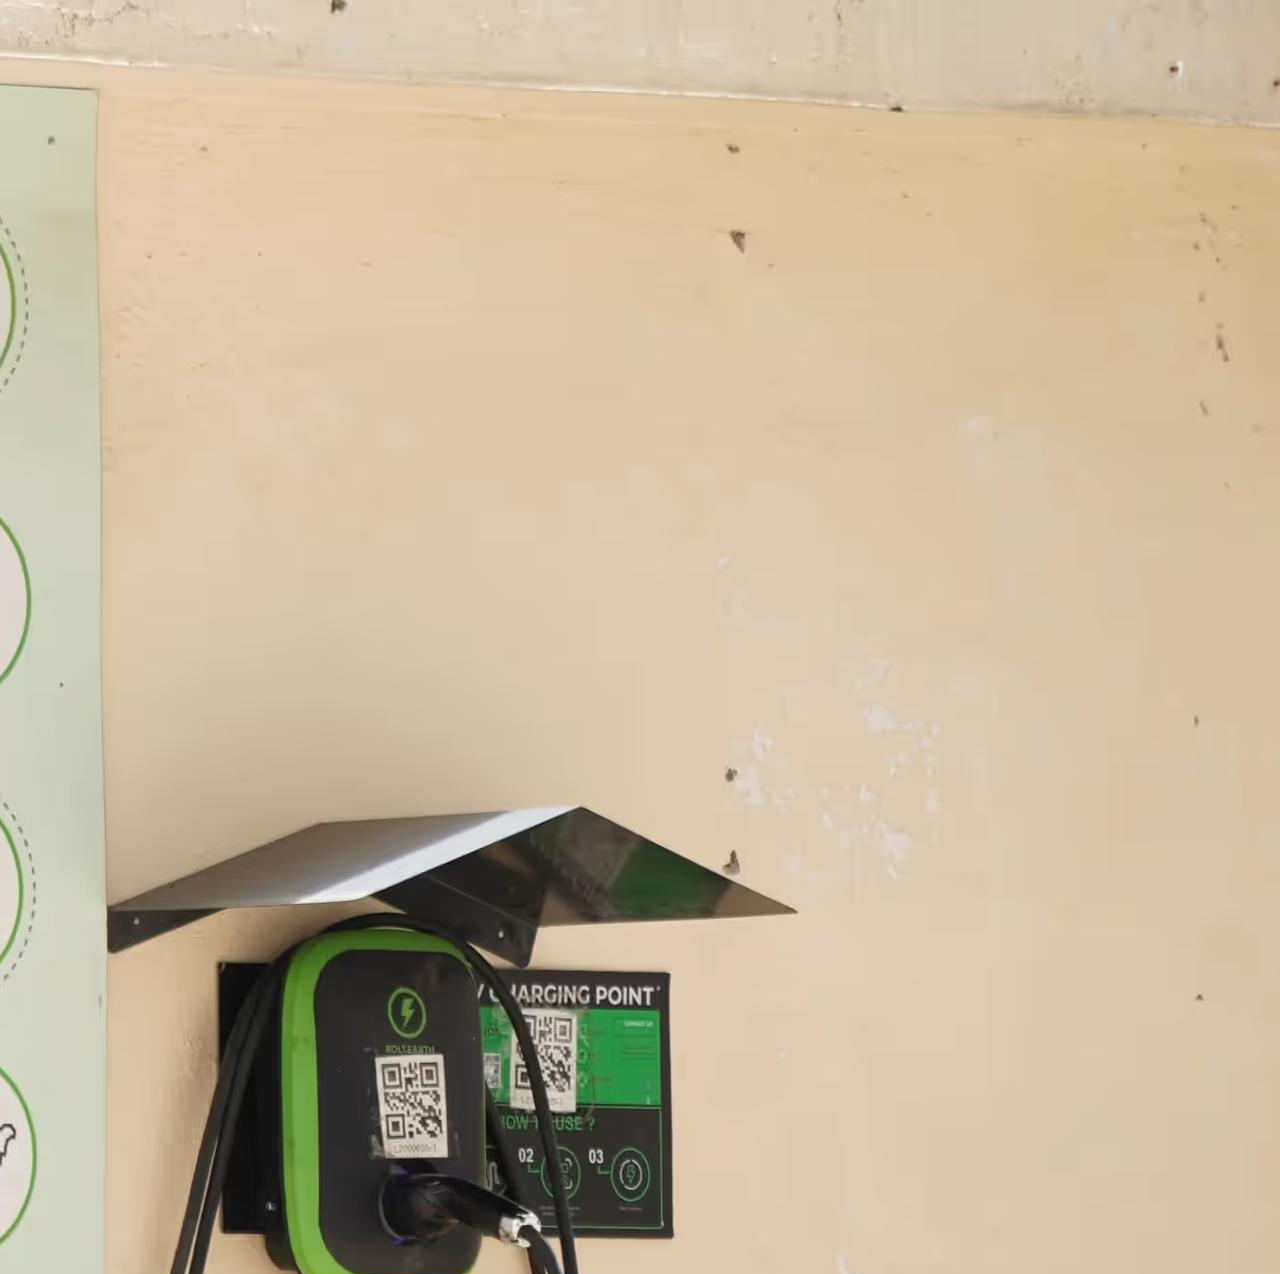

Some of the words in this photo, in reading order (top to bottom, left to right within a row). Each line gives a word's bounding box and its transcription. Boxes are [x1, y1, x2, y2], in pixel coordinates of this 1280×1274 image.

[595, 985, 654, 1006] POINT
[518, 1148, 534, 1163] 02
[588, 1149, 604, 1165] 03
